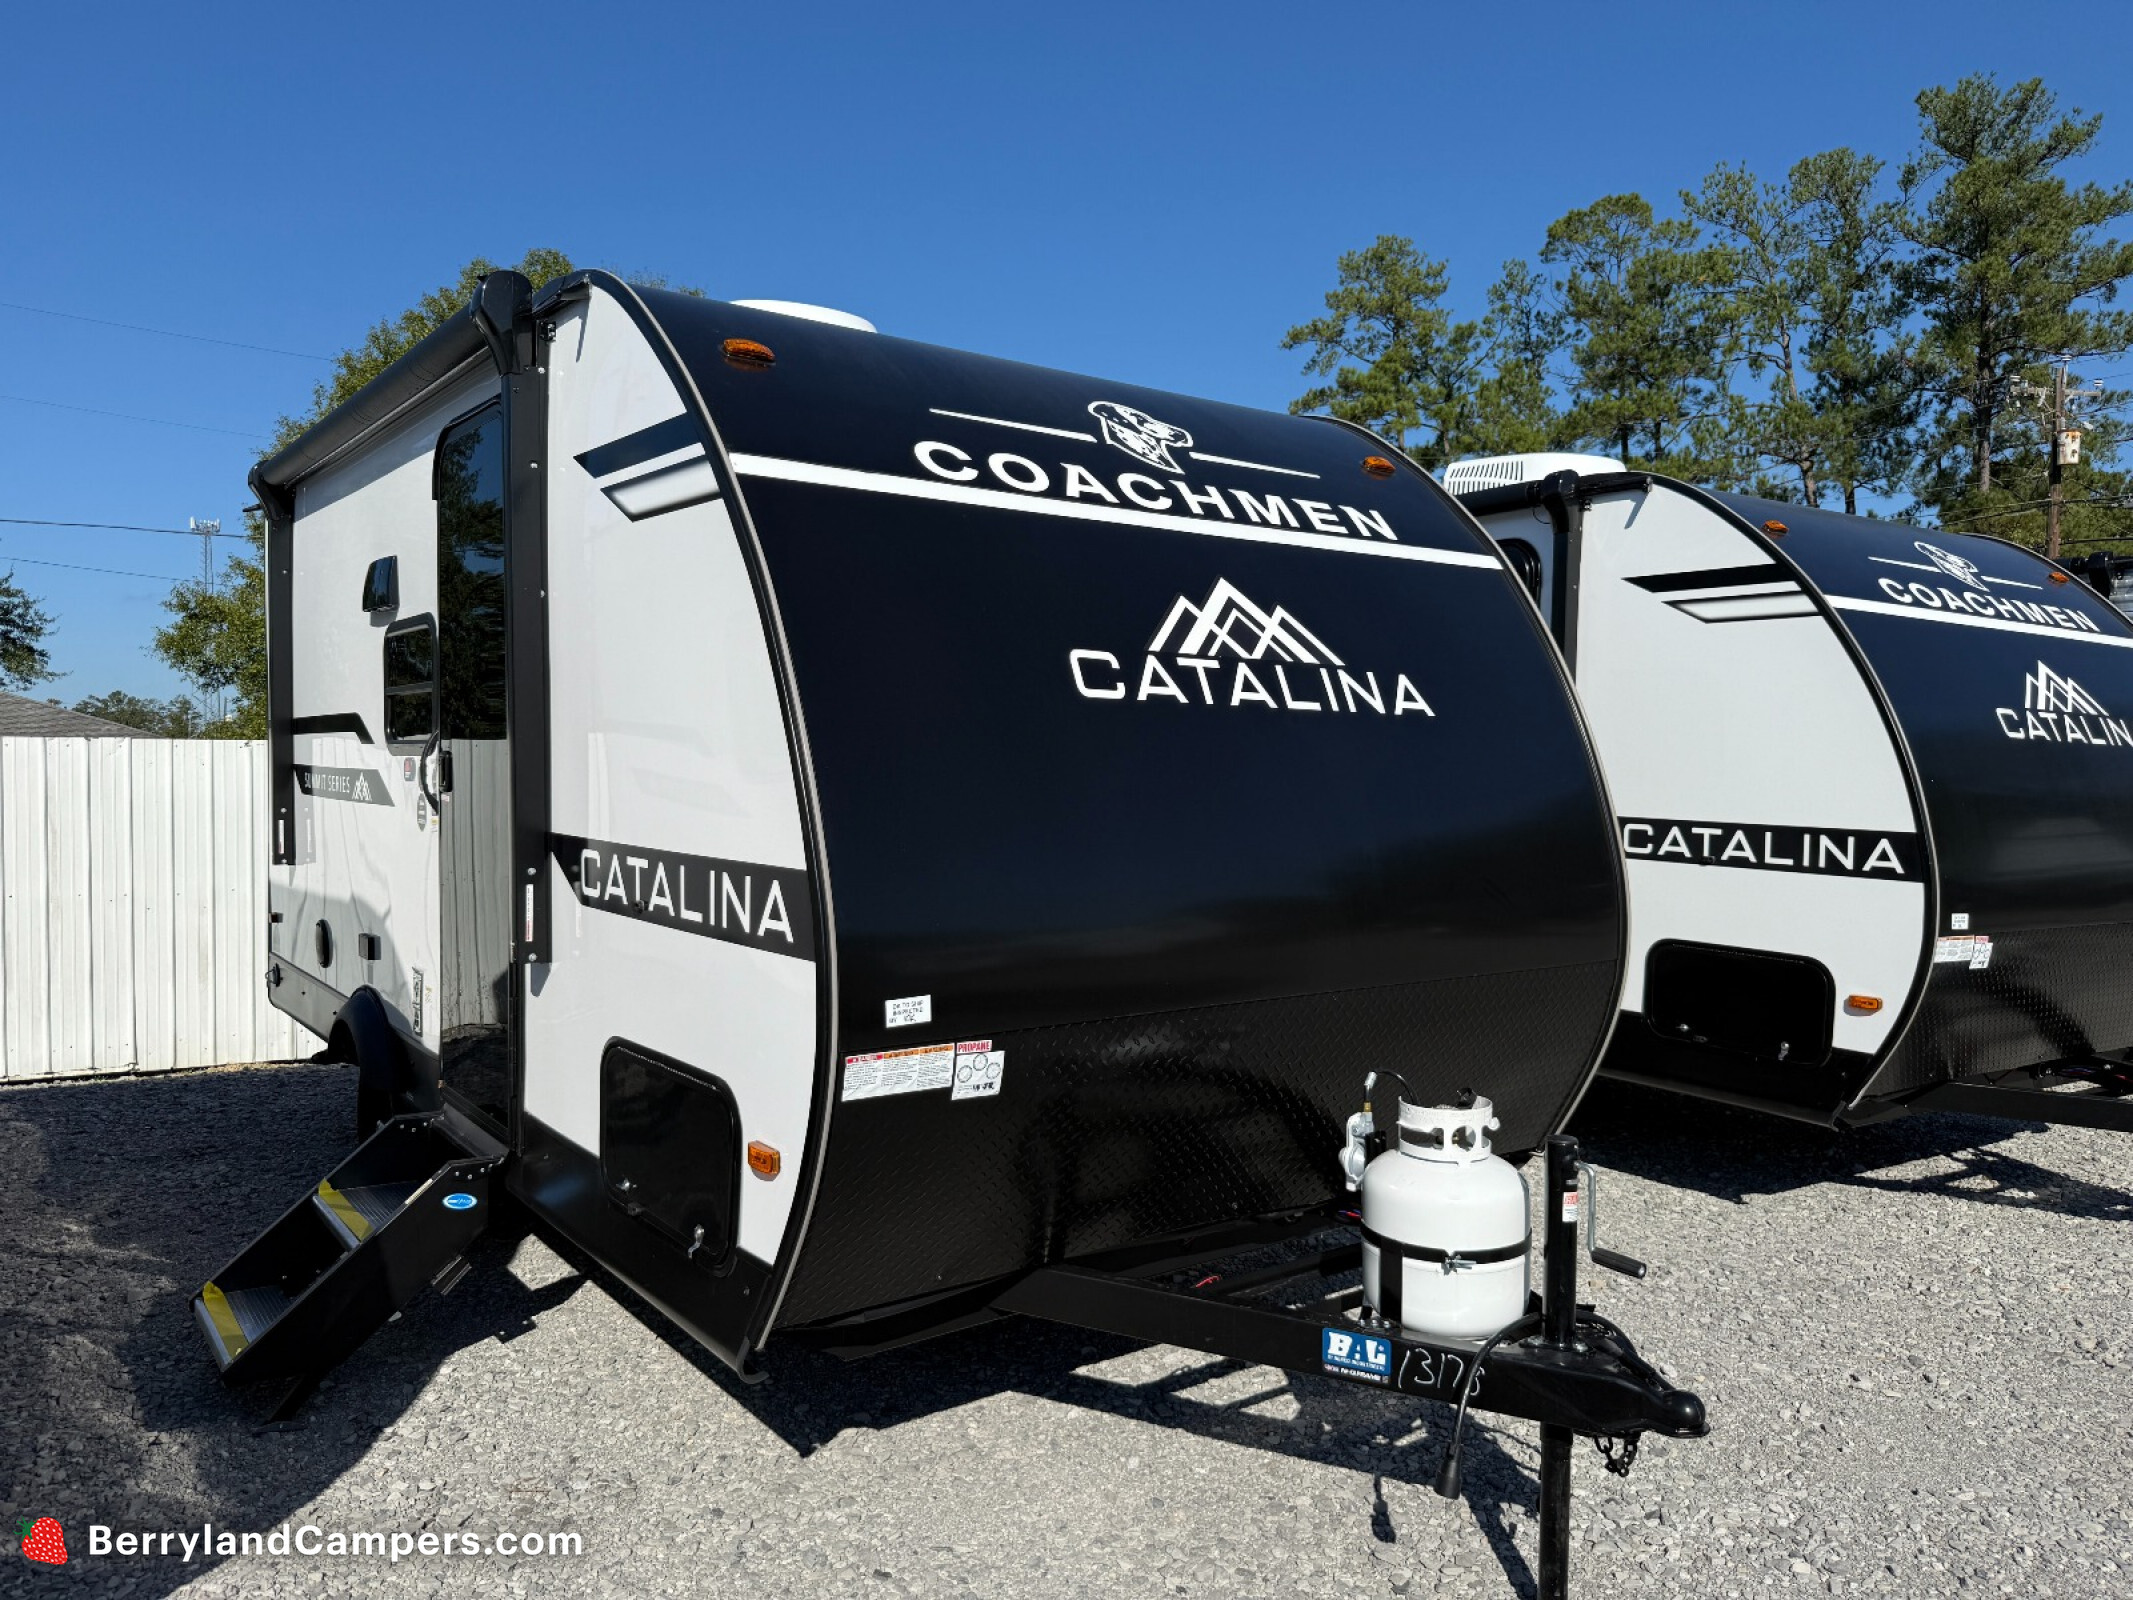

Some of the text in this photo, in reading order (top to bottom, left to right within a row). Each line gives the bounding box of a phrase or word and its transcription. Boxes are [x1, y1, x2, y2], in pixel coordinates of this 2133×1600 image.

[913, 440, 1399, 541] COACHMEN
[1877, 577, 2101, 632] COACHMEN
[1068, 648, 1436, 717] CATALINA
[327, 775, 350, 793] SERIES
[1623, 822, 1905, 875] CATALINA
[580, 848, 795, 943] CATALINA
[957, 1040, 990, 1053] PROPANE
[1327, 1331, 1387, 1365] BAL
